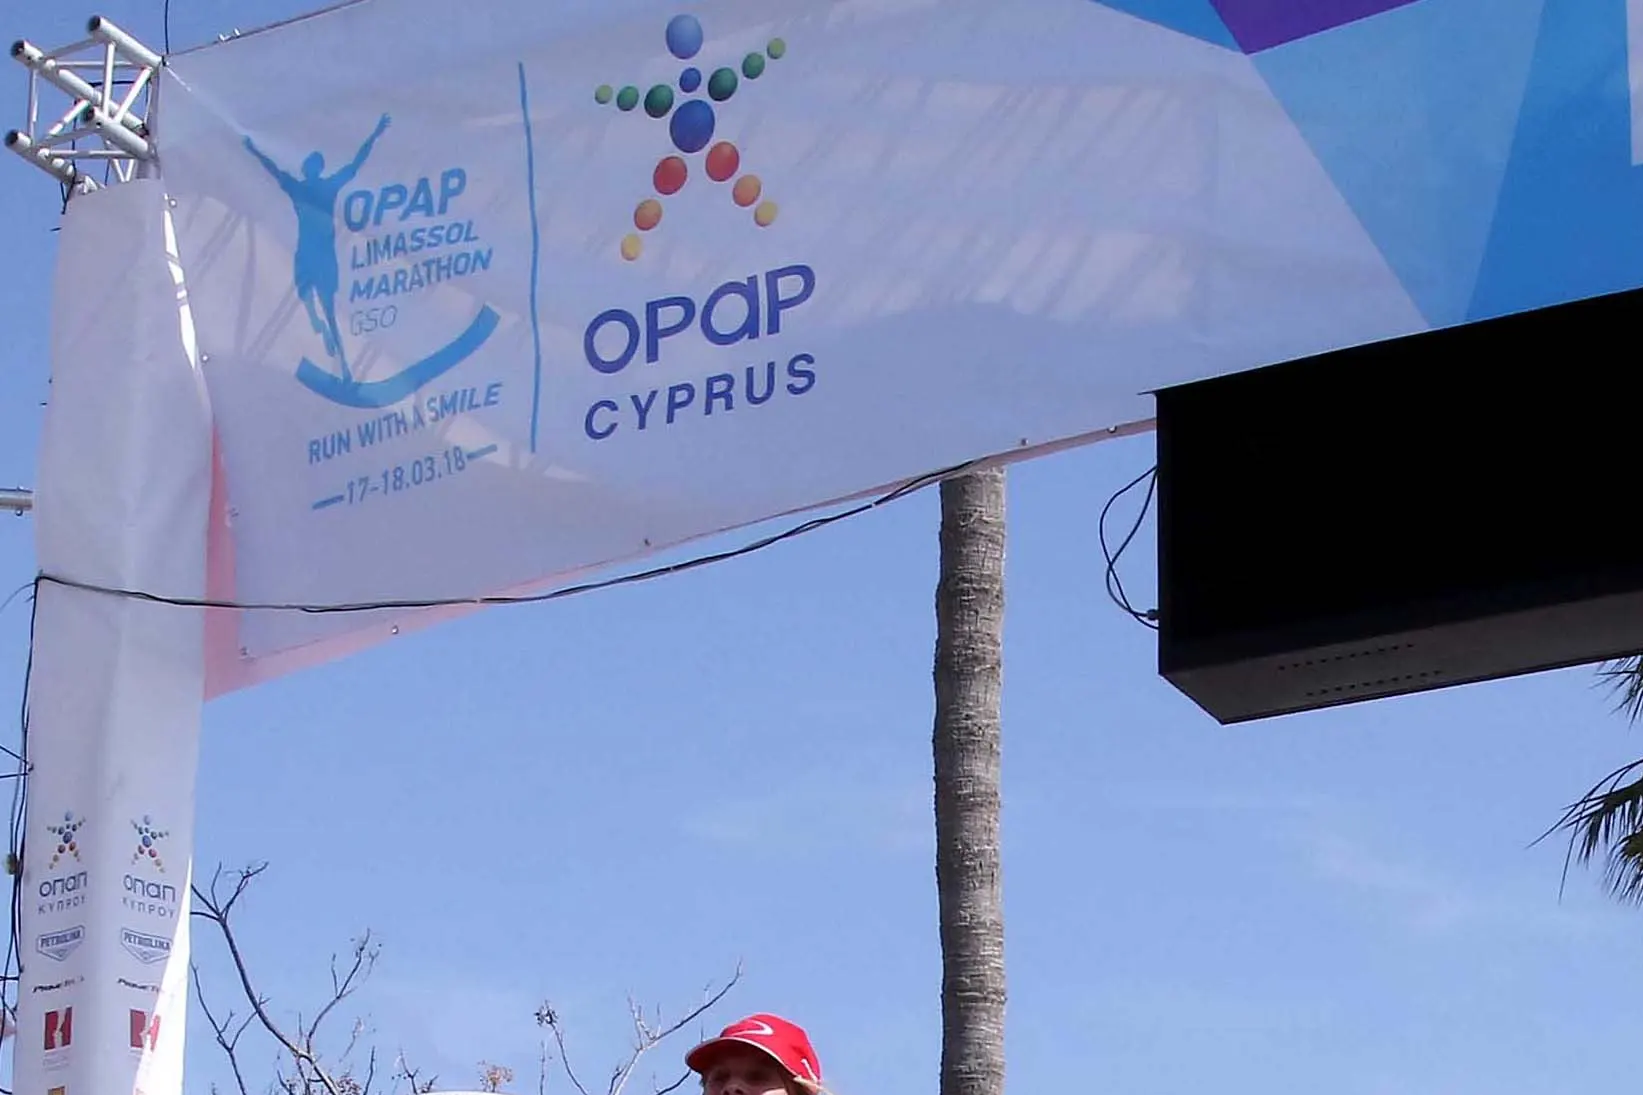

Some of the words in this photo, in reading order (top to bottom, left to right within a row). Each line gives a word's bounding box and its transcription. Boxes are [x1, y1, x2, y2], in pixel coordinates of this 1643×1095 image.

[343, 168, 466, 231] OPAP
[351, 220, 479, 270] LIMASSOL
[351, 248, 493, 303] MARATHON
[351, 305, 398, 336] GSO
[308, 429, 351, 465] RUN
[357, 411, 409, 448] WITH
[412, 405, 426, 431] A
[426, 382, 503, 423] SMILE
[584, 353, 816, 440] CYPRUS
